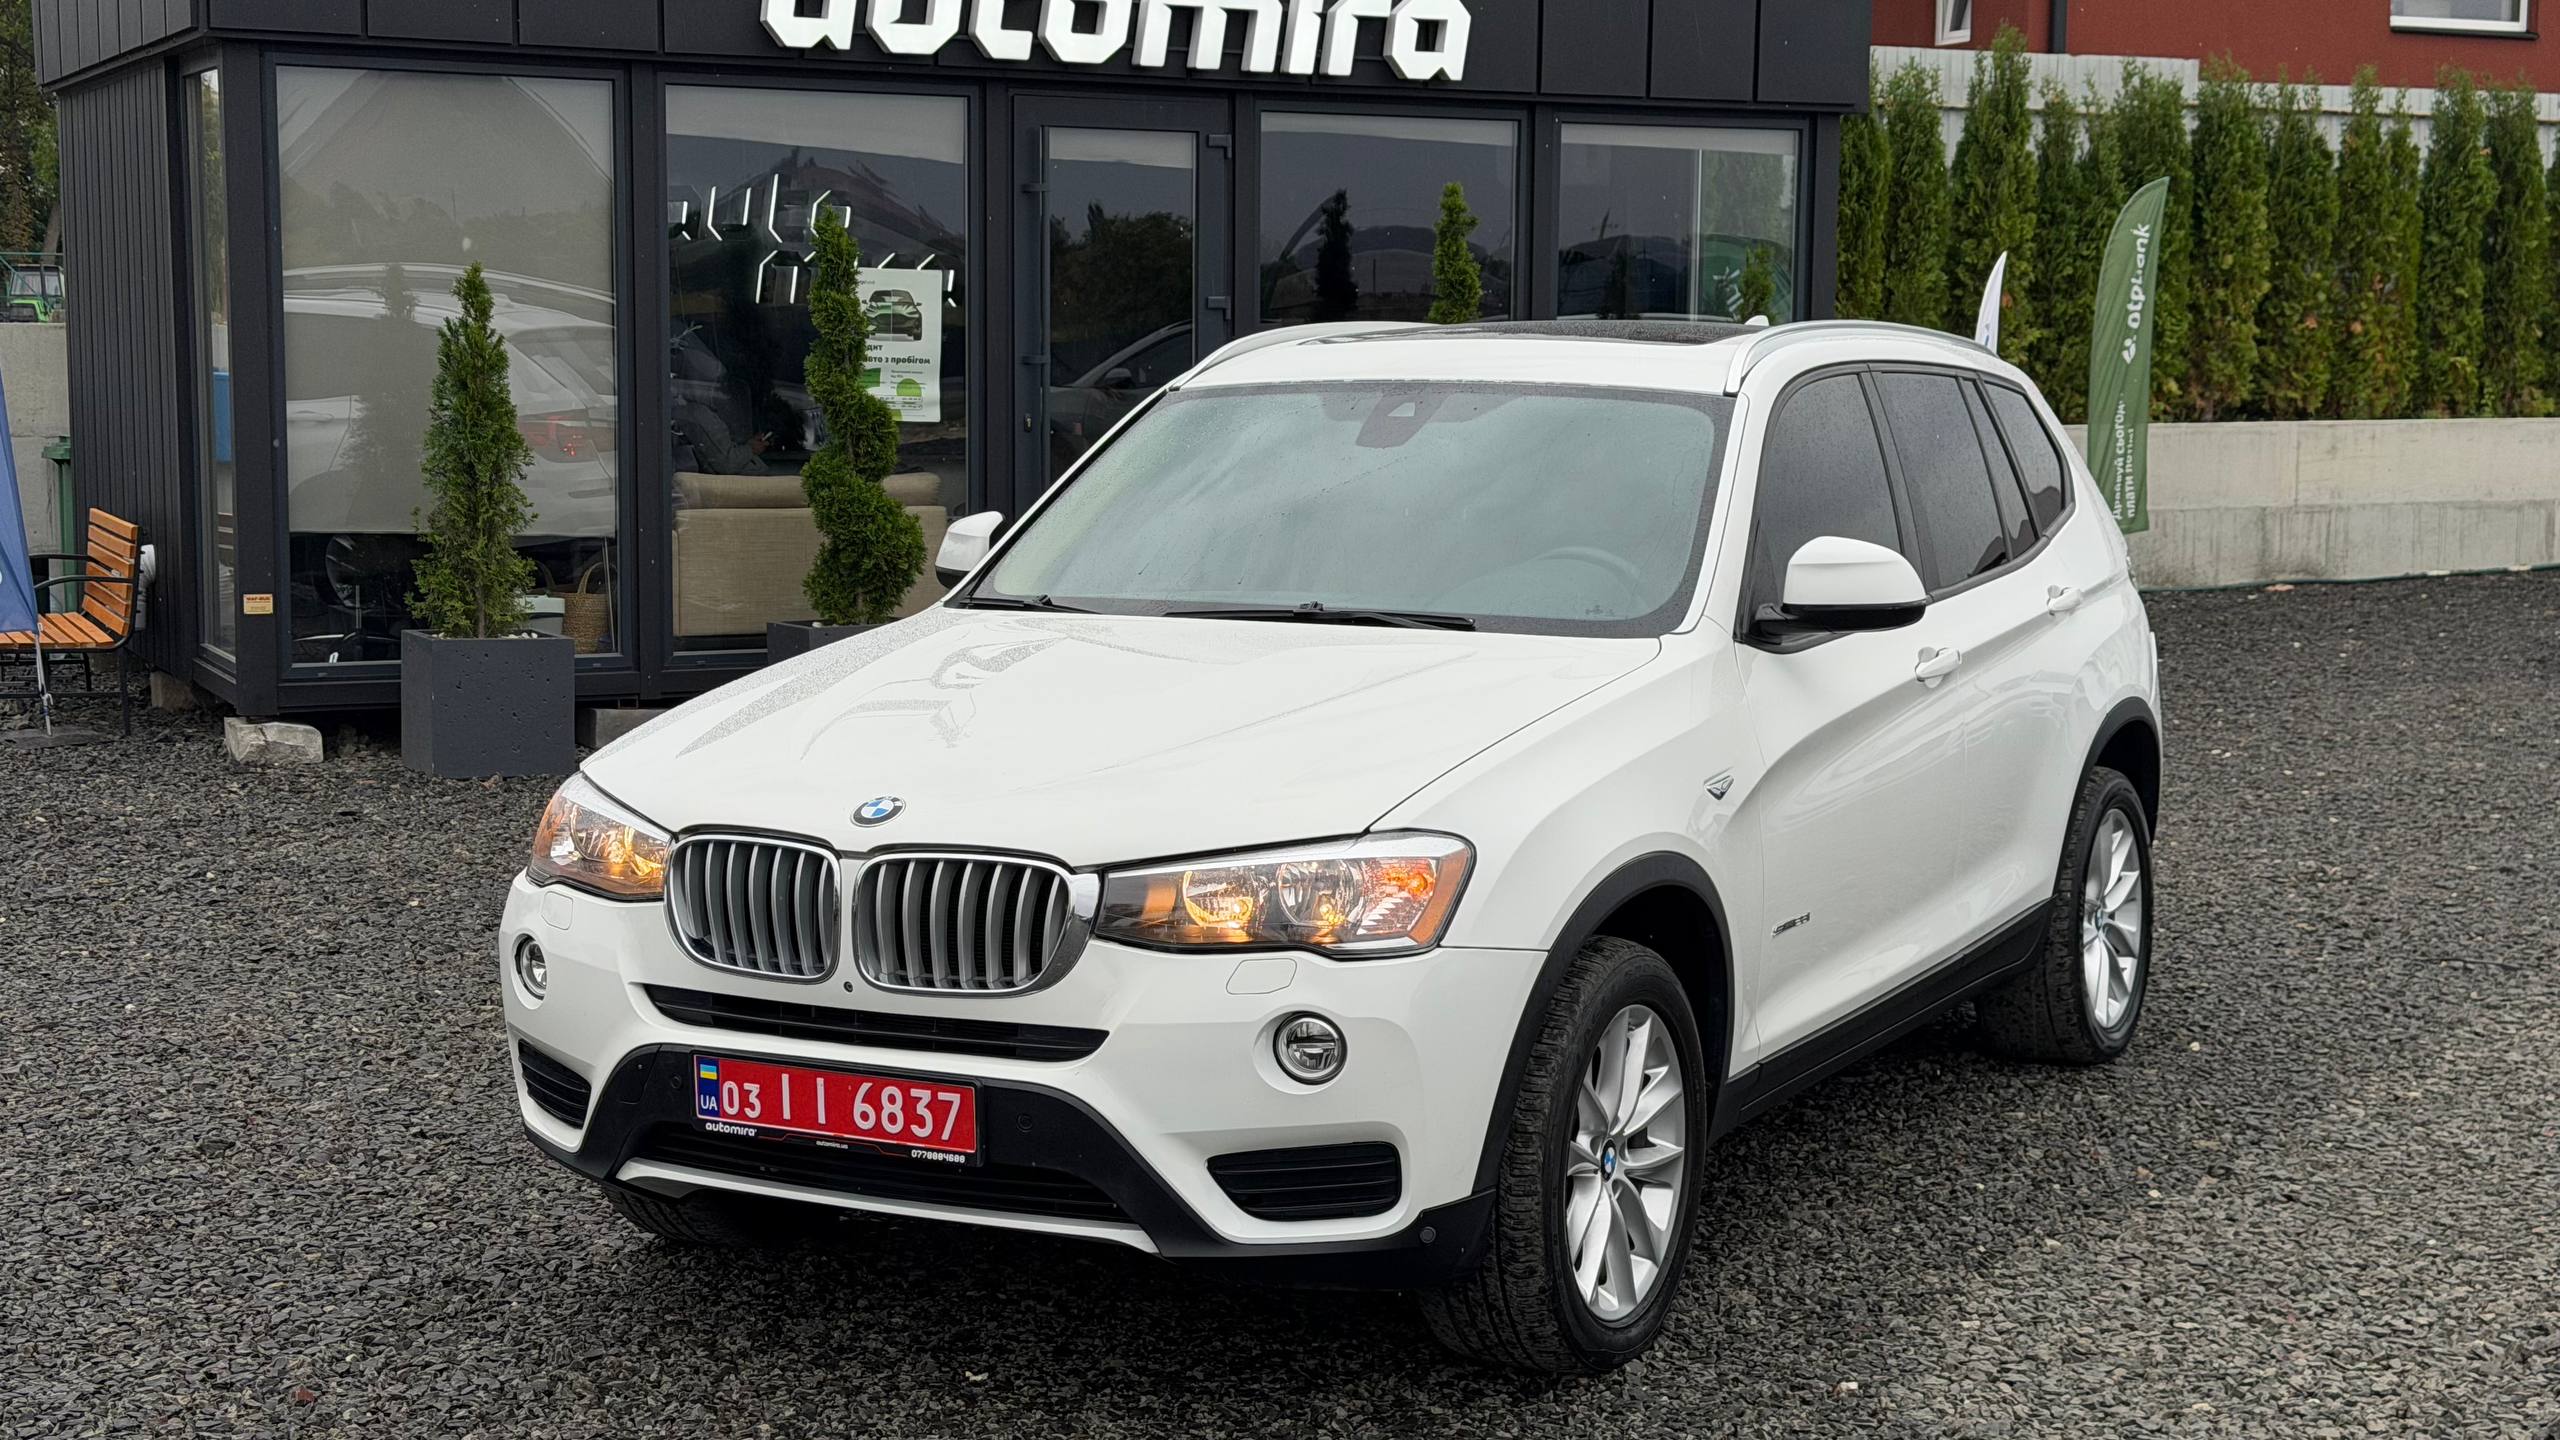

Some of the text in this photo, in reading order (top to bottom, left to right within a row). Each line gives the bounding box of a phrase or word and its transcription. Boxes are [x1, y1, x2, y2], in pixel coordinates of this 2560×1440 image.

[890, 355, 931, 365] пробігом
[700, 1094, 718, 1111] UA
[722, 1080, 761, 1119] 03
[853, 1082, 961, 1141] 6837
[705, 1122, 755, 1137] automira
